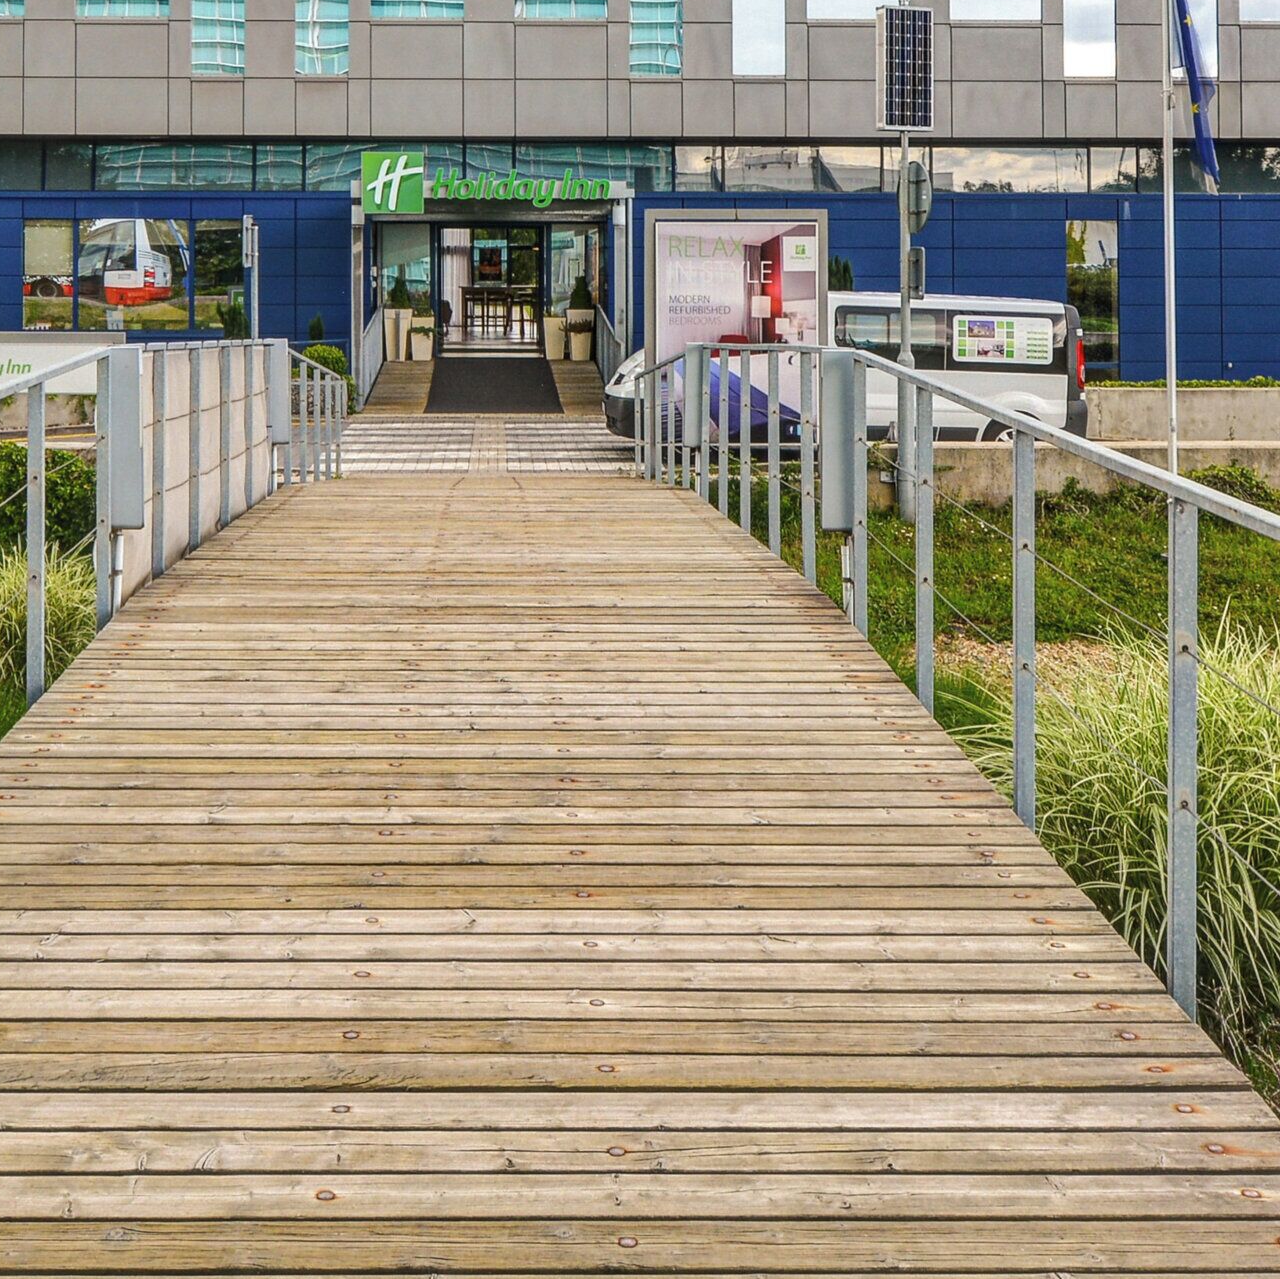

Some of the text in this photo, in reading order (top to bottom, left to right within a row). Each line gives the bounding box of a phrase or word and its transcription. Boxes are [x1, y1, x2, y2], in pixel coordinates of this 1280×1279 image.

[432, 167, 556, 208] Holiday
[561, 168, 612, 200] Inn
[668, 235, 745, 258] RELAX
[701, 260, 773, 283] STYLE
[669, 294, 711, 304] MODERN
[669, 305, 731, 315] REFURBISHED
[669, 316, 722, 325] BEDROOMS
[6, 359, 32, 374] Inn
